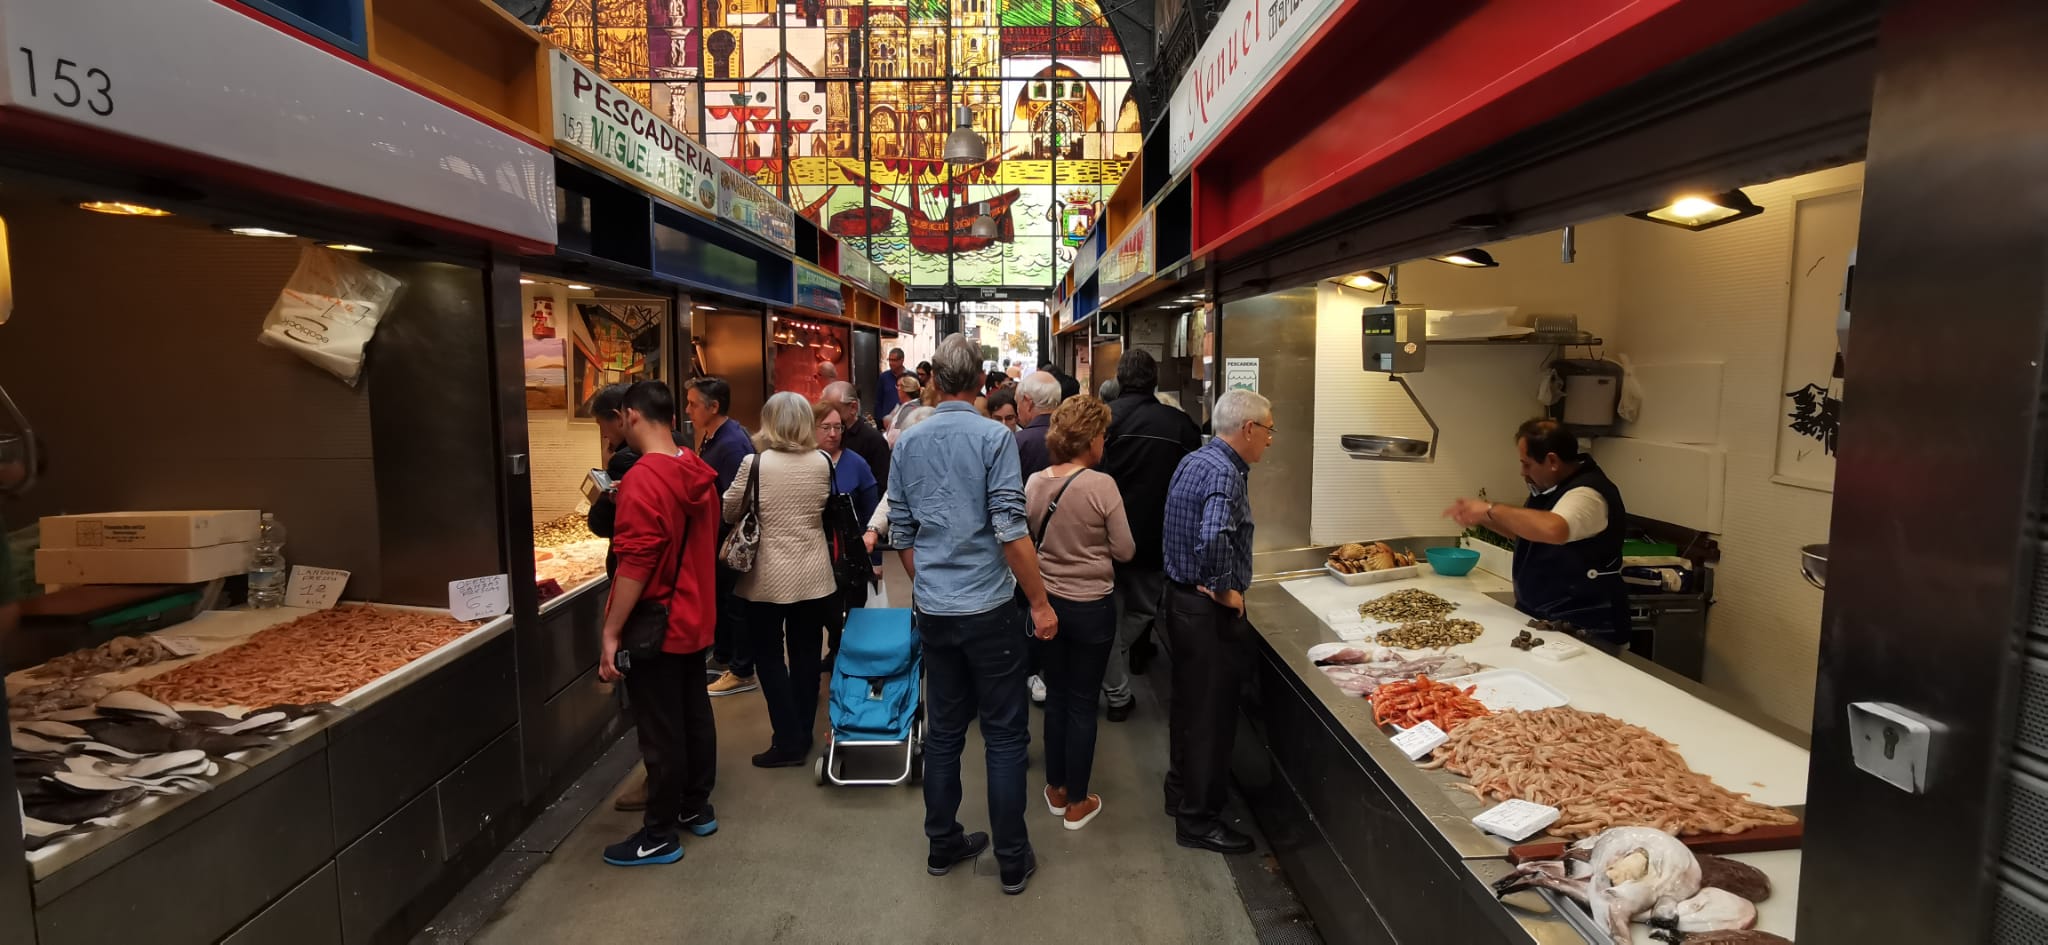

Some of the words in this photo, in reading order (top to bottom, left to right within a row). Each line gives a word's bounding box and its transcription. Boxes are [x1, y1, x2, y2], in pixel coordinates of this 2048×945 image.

[20, 47, 114, 116] 153
[1188, 0, 1260, 141] Manuel
[563, 113, 584, 145] 152
[572, 67, 714, 180] PESCADERIA
[591, 115, 652, 178] MIGUEL
[656, 156, 697, 202] ANGEL
[281, 316, 329, 344] ecoblock
